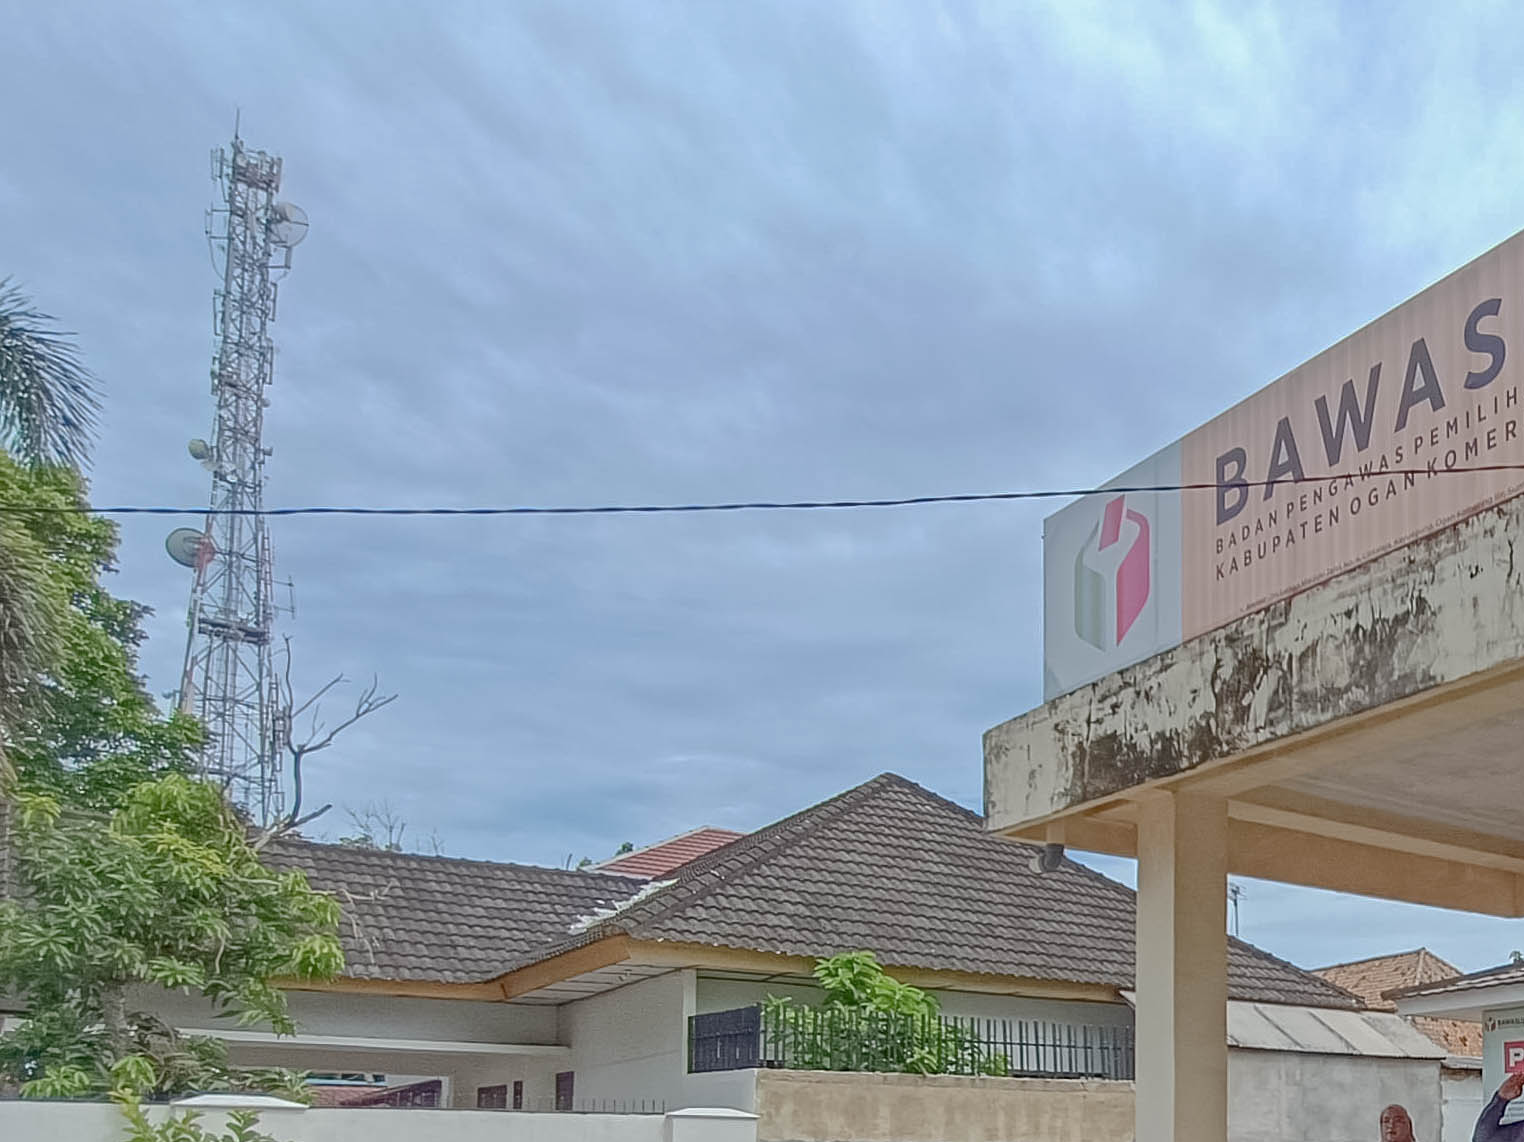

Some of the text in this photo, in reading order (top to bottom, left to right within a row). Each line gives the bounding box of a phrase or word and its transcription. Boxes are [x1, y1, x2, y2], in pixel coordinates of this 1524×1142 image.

[1216, 510, 1278, 555] BADAN
[1286, 446, 1403, 518] PENGAWAS
[1216, 506, 1340, 581] KABUPATEN
[1350, 470, 1416, 515] OGAN
